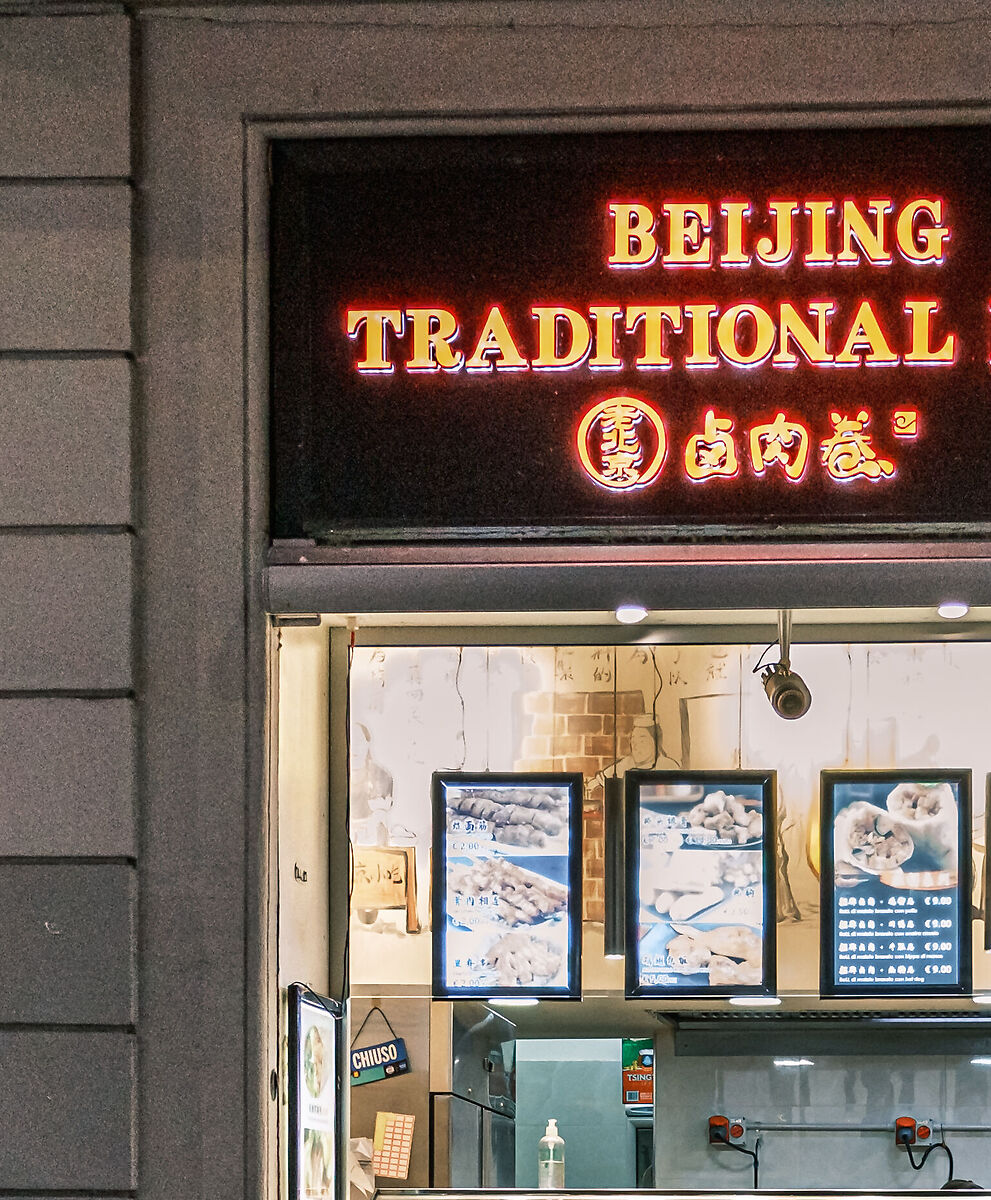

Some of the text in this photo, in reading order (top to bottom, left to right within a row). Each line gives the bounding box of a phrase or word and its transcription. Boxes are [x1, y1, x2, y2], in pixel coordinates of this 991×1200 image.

[608, 198, 950, 269] BEIJING
[346, 300, 958, 374] TRADITIONAL
[685, 410, 897, 483] 卤肉卷
[352, 1043, 398, 1070] CHIUSO
[627, 1074, 654, 1082] TSING
